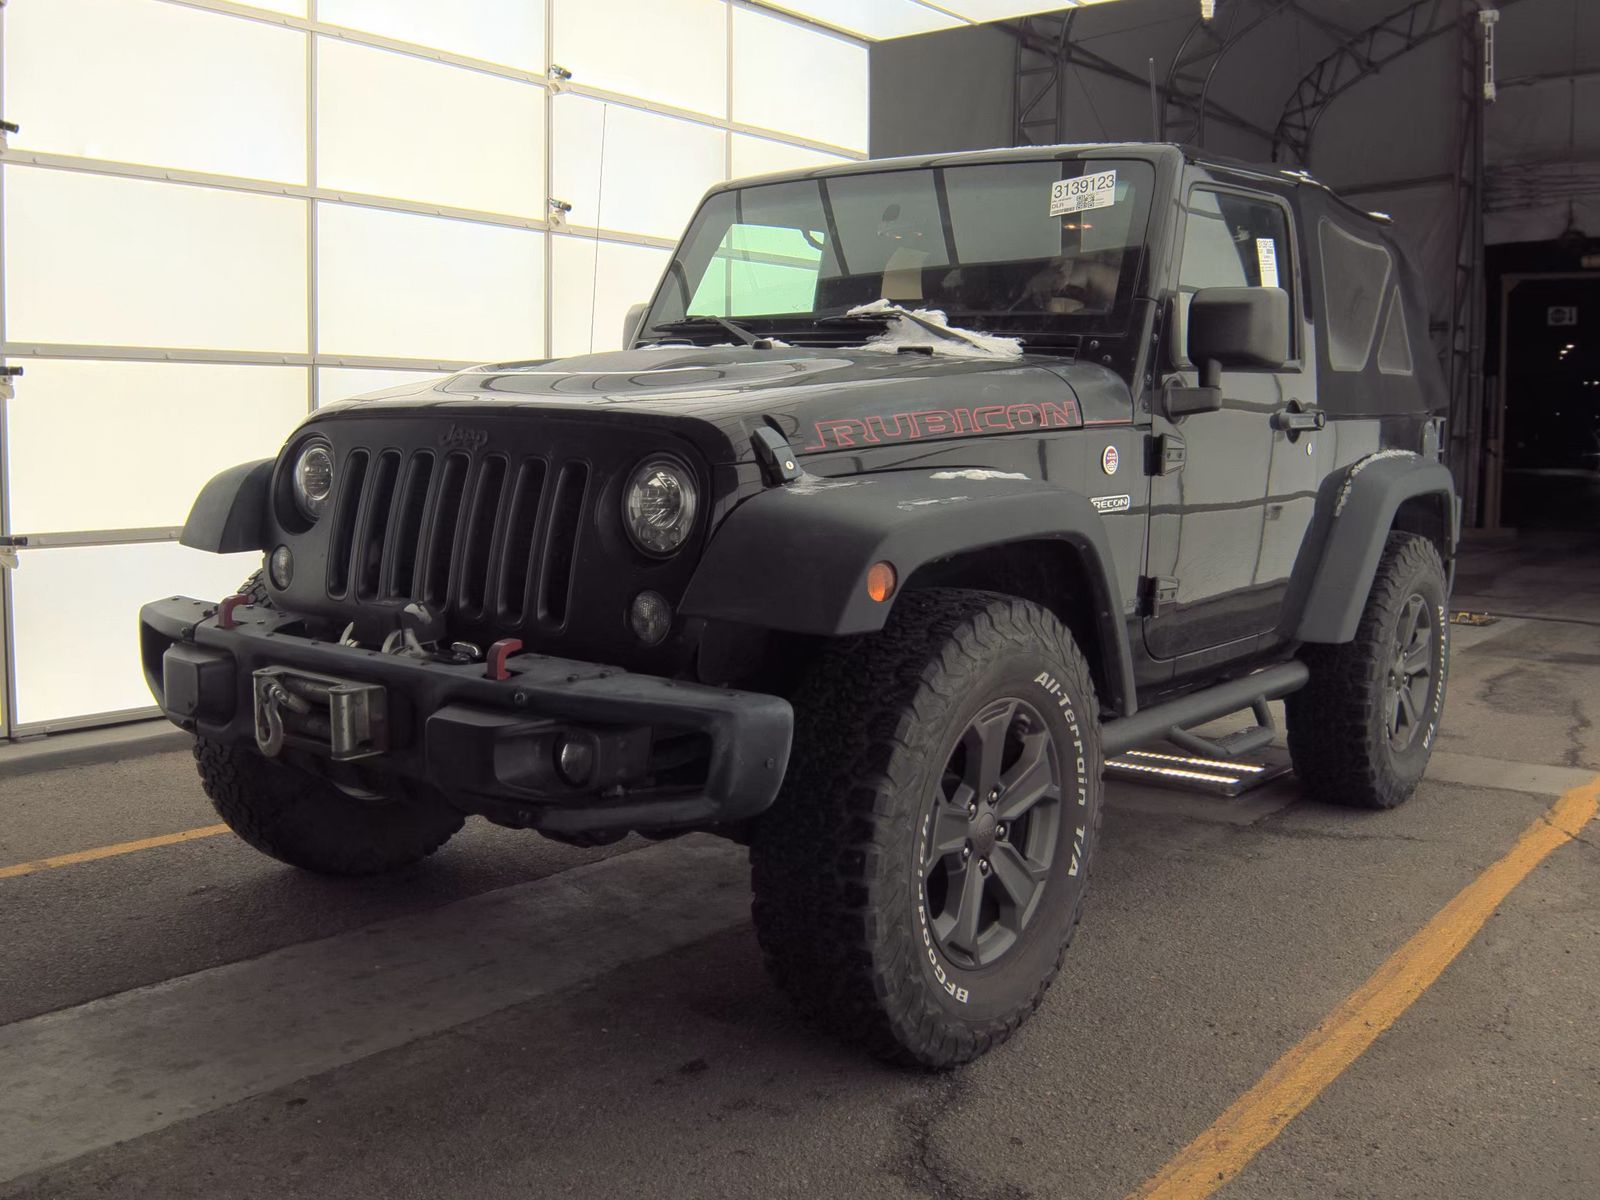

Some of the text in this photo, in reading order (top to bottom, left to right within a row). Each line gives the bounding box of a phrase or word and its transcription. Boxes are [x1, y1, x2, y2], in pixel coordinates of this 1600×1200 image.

[1054, 174, 1115, 199] 3139123
[804, 400, 1082, 450] RUBICON
[1093, 498, 1128, 509] RECON
[1422, 605, 1446, 749] All-Terrain T/A
[1032, 670, 1088, 877] All-Terrain T/A
[917, 813, 969, 1004] BFGoodrich
